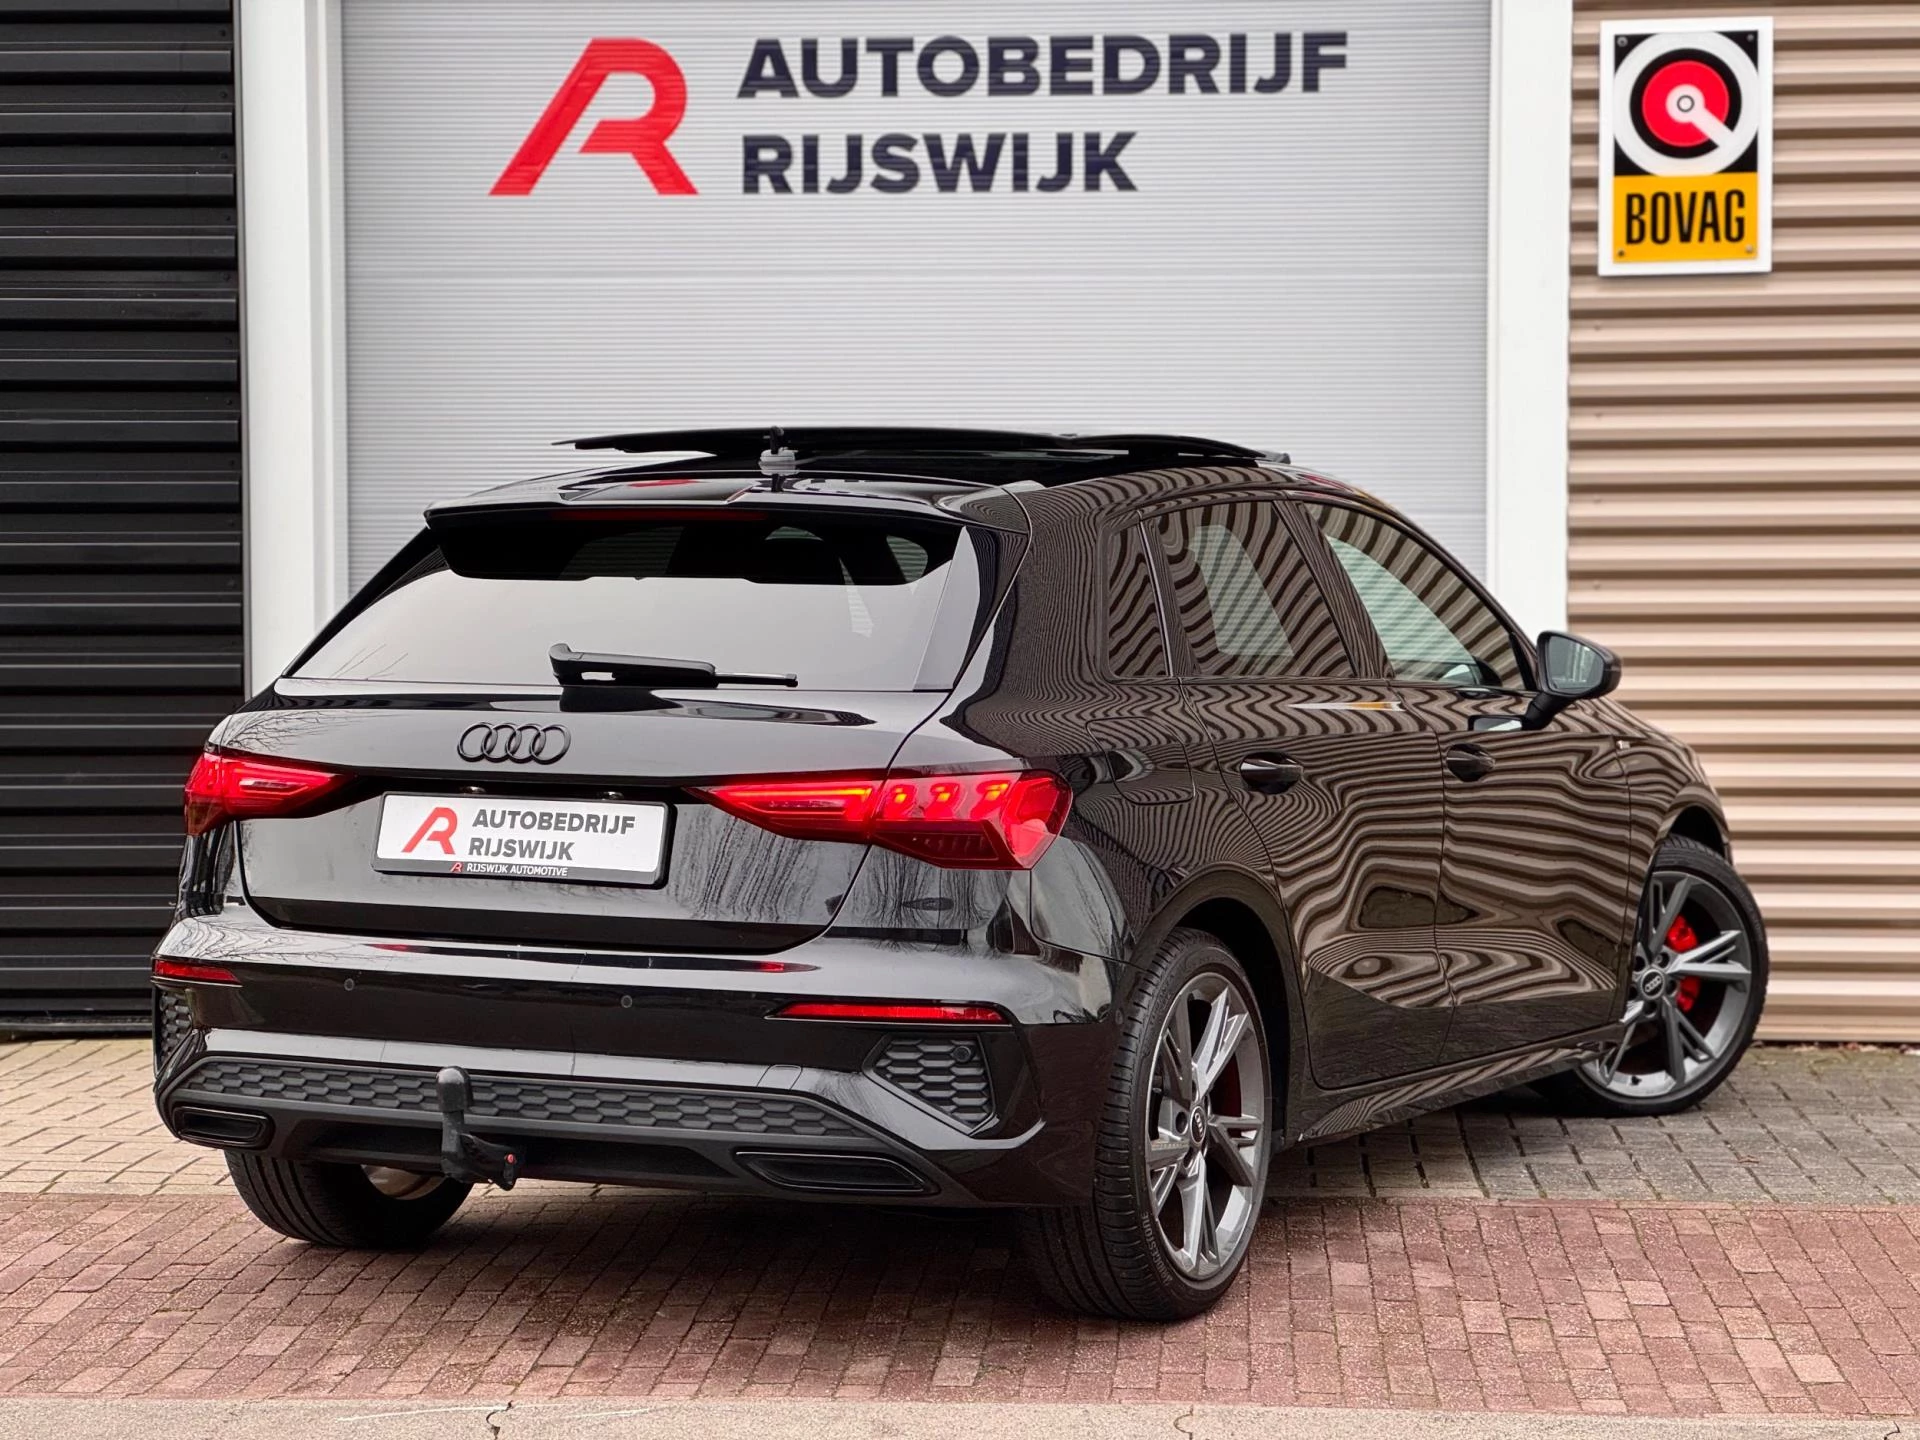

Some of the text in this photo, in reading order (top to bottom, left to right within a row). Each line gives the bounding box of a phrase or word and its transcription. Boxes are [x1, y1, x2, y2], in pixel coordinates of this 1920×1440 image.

[736, 32, 1347, 99] AUTOBEDRIJF
[742, 131, 1138, 194] RIJSWIJK
[1625, 189, 1745, 245] BOVAG
[472, 809, 636, 835] AUTOBEDRIJF
[466, 862, 508, 873] RIJSWIJK
[509, 864, 569, 876] AUTOMOTIVE
[468, 837, 575, 861] RIJSWIJK
